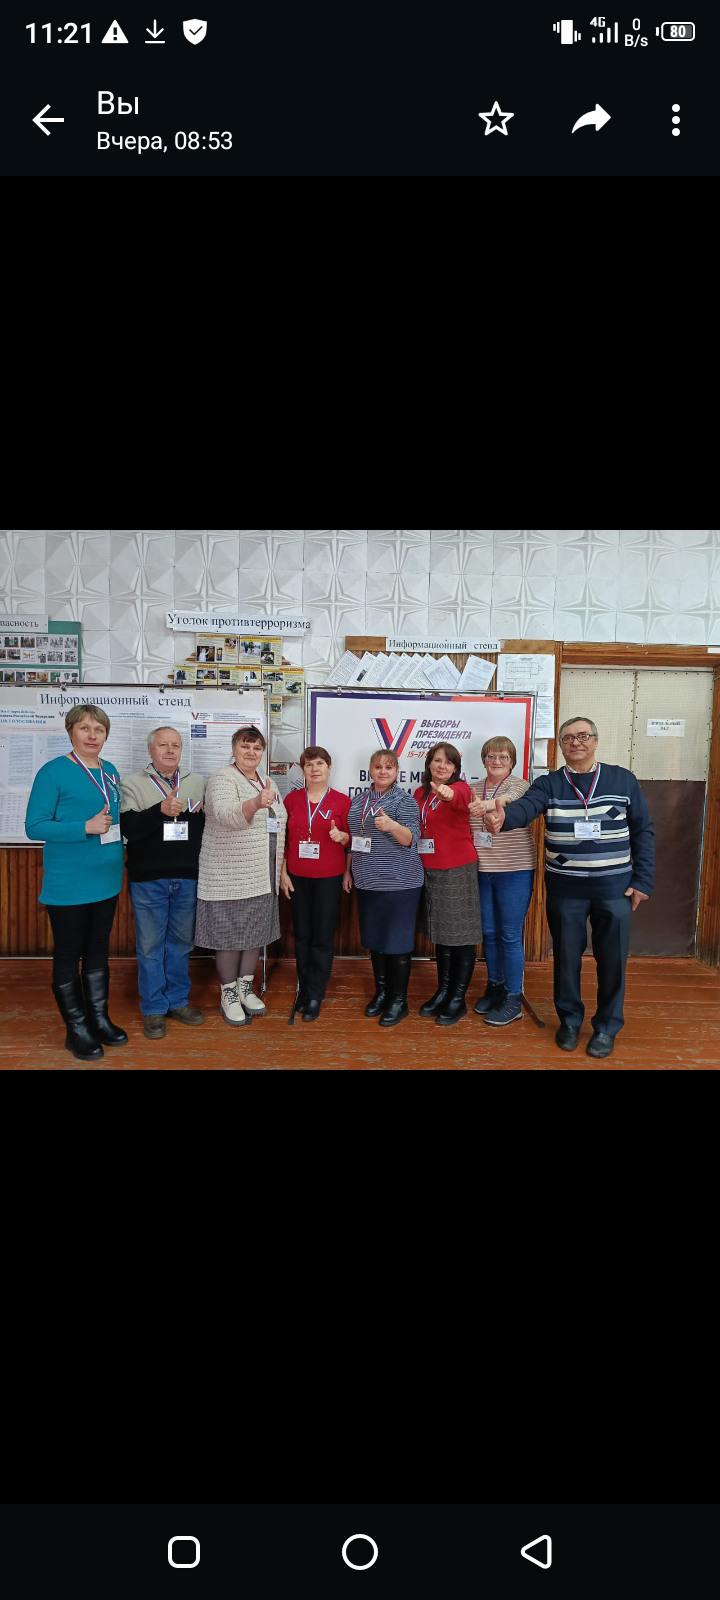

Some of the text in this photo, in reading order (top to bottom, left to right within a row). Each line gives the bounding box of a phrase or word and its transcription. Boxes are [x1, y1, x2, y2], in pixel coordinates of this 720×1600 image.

[167, 613, 311, 630] Уголок противтерроризма
[389, 639, 467, 650] Информационный
[40, 693, 192, 708] Информационный стенд
[420, 719, 461, 729] ВЫБОРЫ
[415, 730, 472, 740] ПРЕЗИДЕНТА
